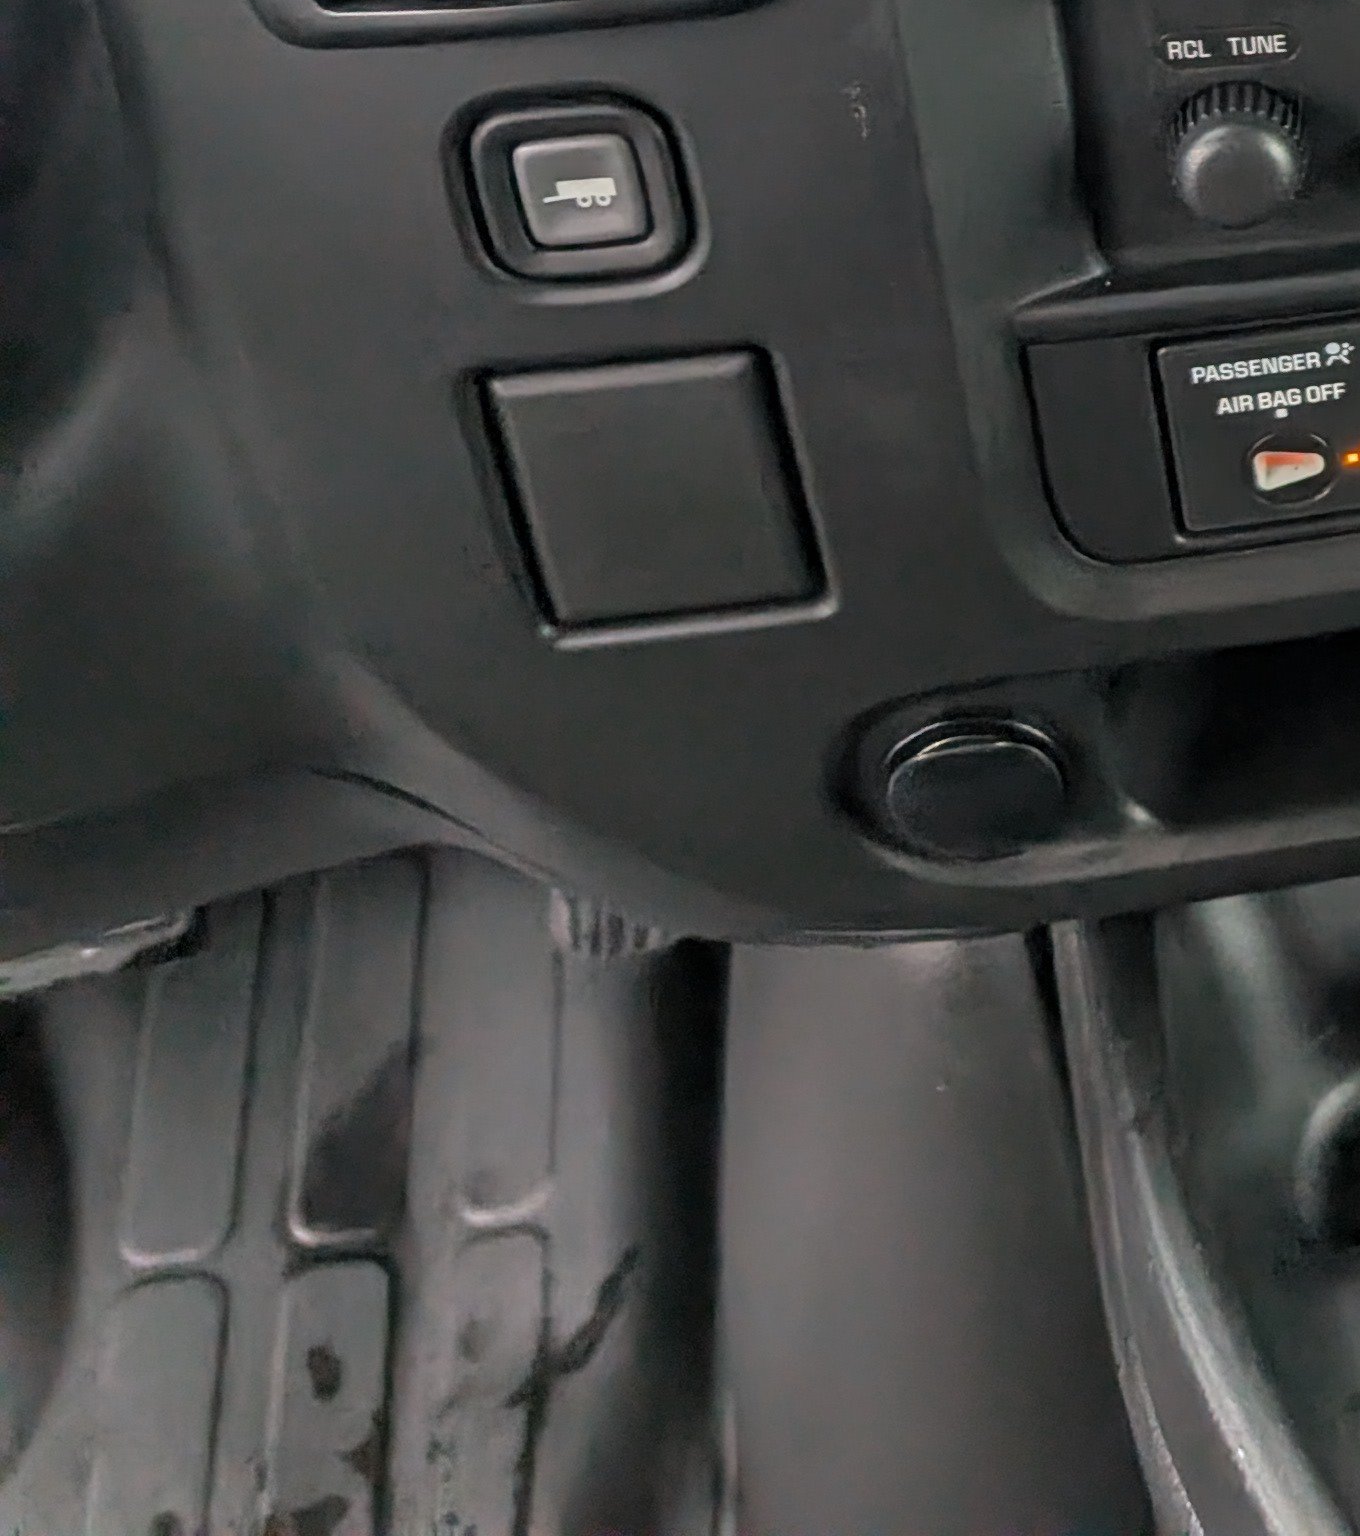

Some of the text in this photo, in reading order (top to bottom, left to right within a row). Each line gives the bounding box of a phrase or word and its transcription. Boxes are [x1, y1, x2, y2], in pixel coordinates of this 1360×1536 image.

[1166, 34, 1288, 60] RCL TUNE
[1190, 351, 1322, 384] PASSENGER
[1216, 381, 1347, 415] AIR BAG OFF
